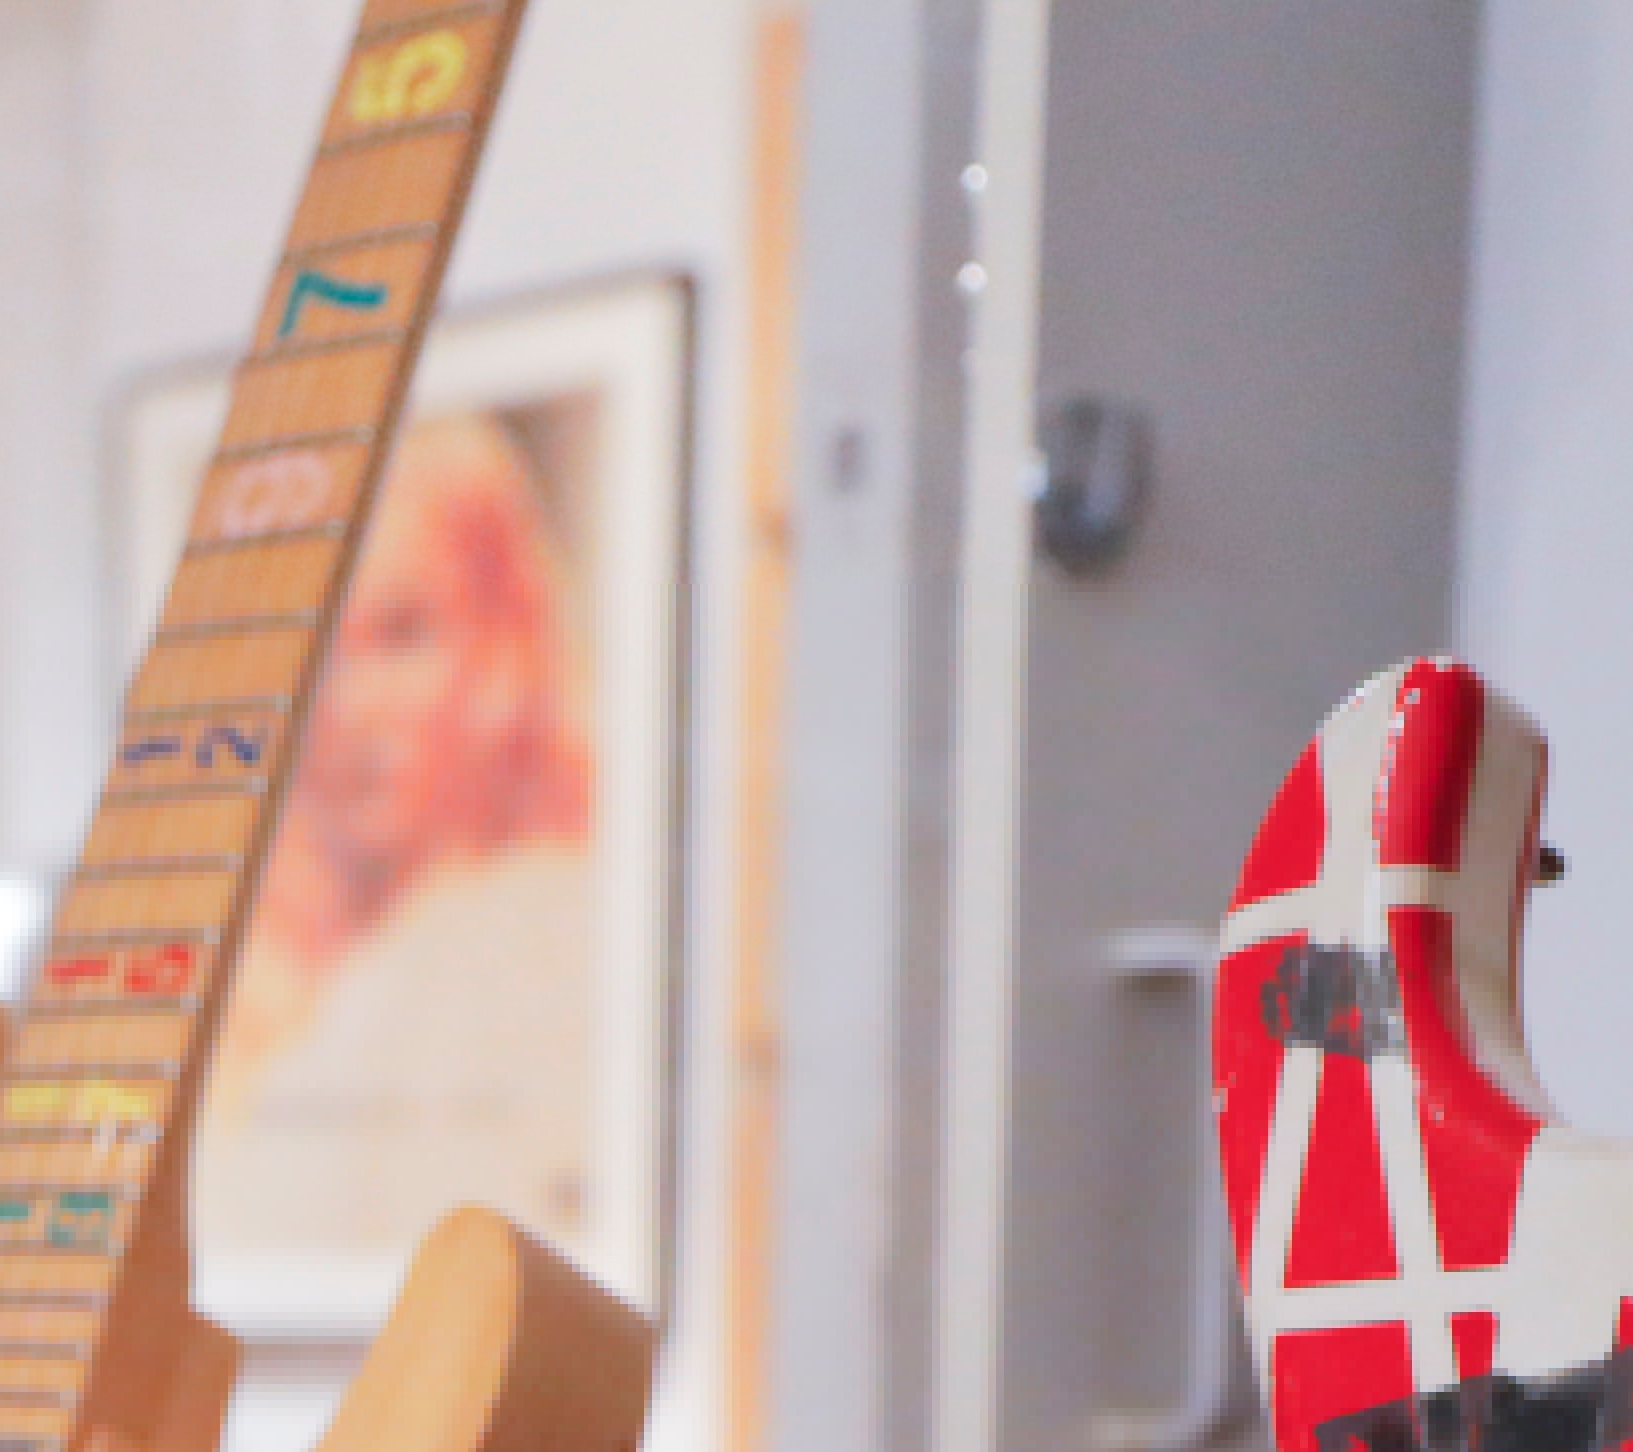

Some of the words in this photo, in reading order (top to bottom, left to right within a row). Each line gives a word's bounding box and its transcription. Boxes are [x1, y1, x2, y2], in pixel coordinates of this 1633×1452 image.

[349, 30, 466, 120] 5
[277, 270, 386, 338] 7
[122, 724, 262, 767] 12
